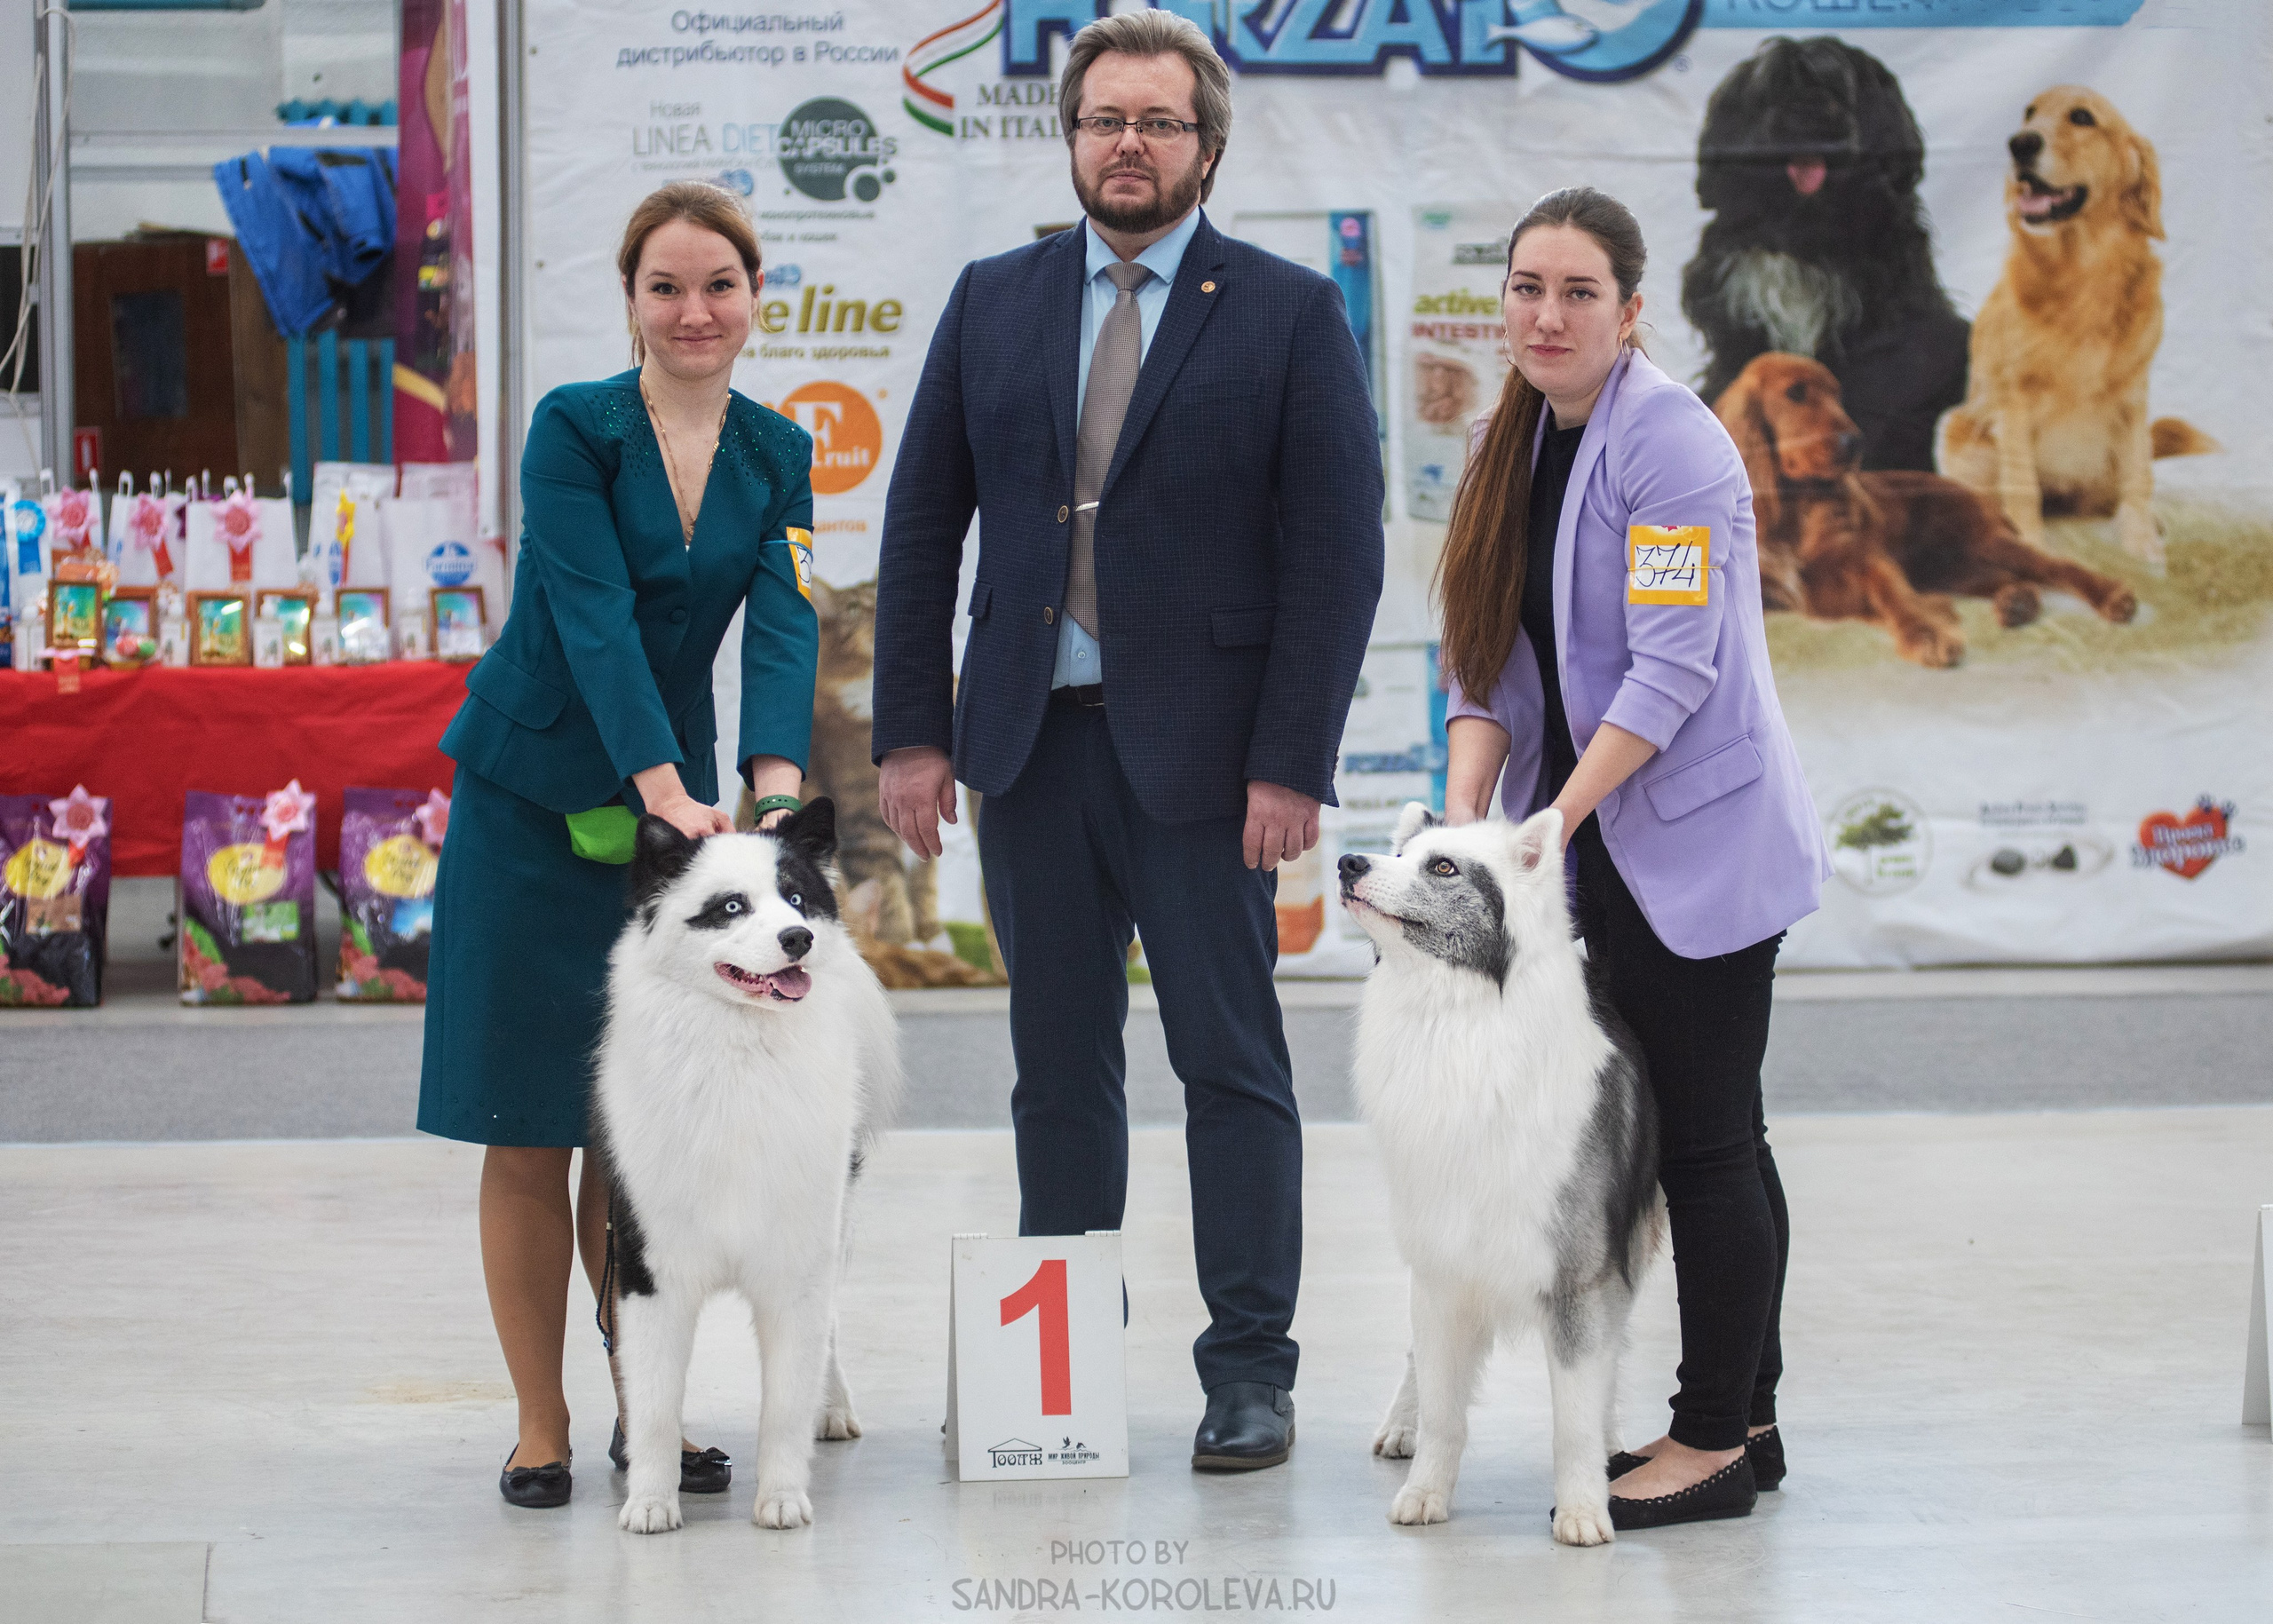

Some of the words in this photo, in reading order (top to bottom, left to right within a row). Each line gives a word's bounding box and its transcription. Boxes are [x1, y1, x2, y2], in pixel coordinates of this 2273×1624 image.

[671, 10, 843, 34] Официальный
[616, 39, 784, 68] дистрибьютор
[792, 45, 806, 62] в
[814, 41, 899, 63] России
[649, 100, 701, 117] Новая
[790, 119, 867, 137] MICRO
[962, 115, 990, 138] IN
[1000, 115, 1064, 138] ITAL
[632, 123, 712, 155] LINEA
[779, 136, 898, 158] CAPSULES
[797, 284, 903, 333] line
[1635, 541, 1695, 587] 374
[1000, 1259, 1072, 1416] 1
[1060, 1451, 1076, 1460] ЖИВОЙ
